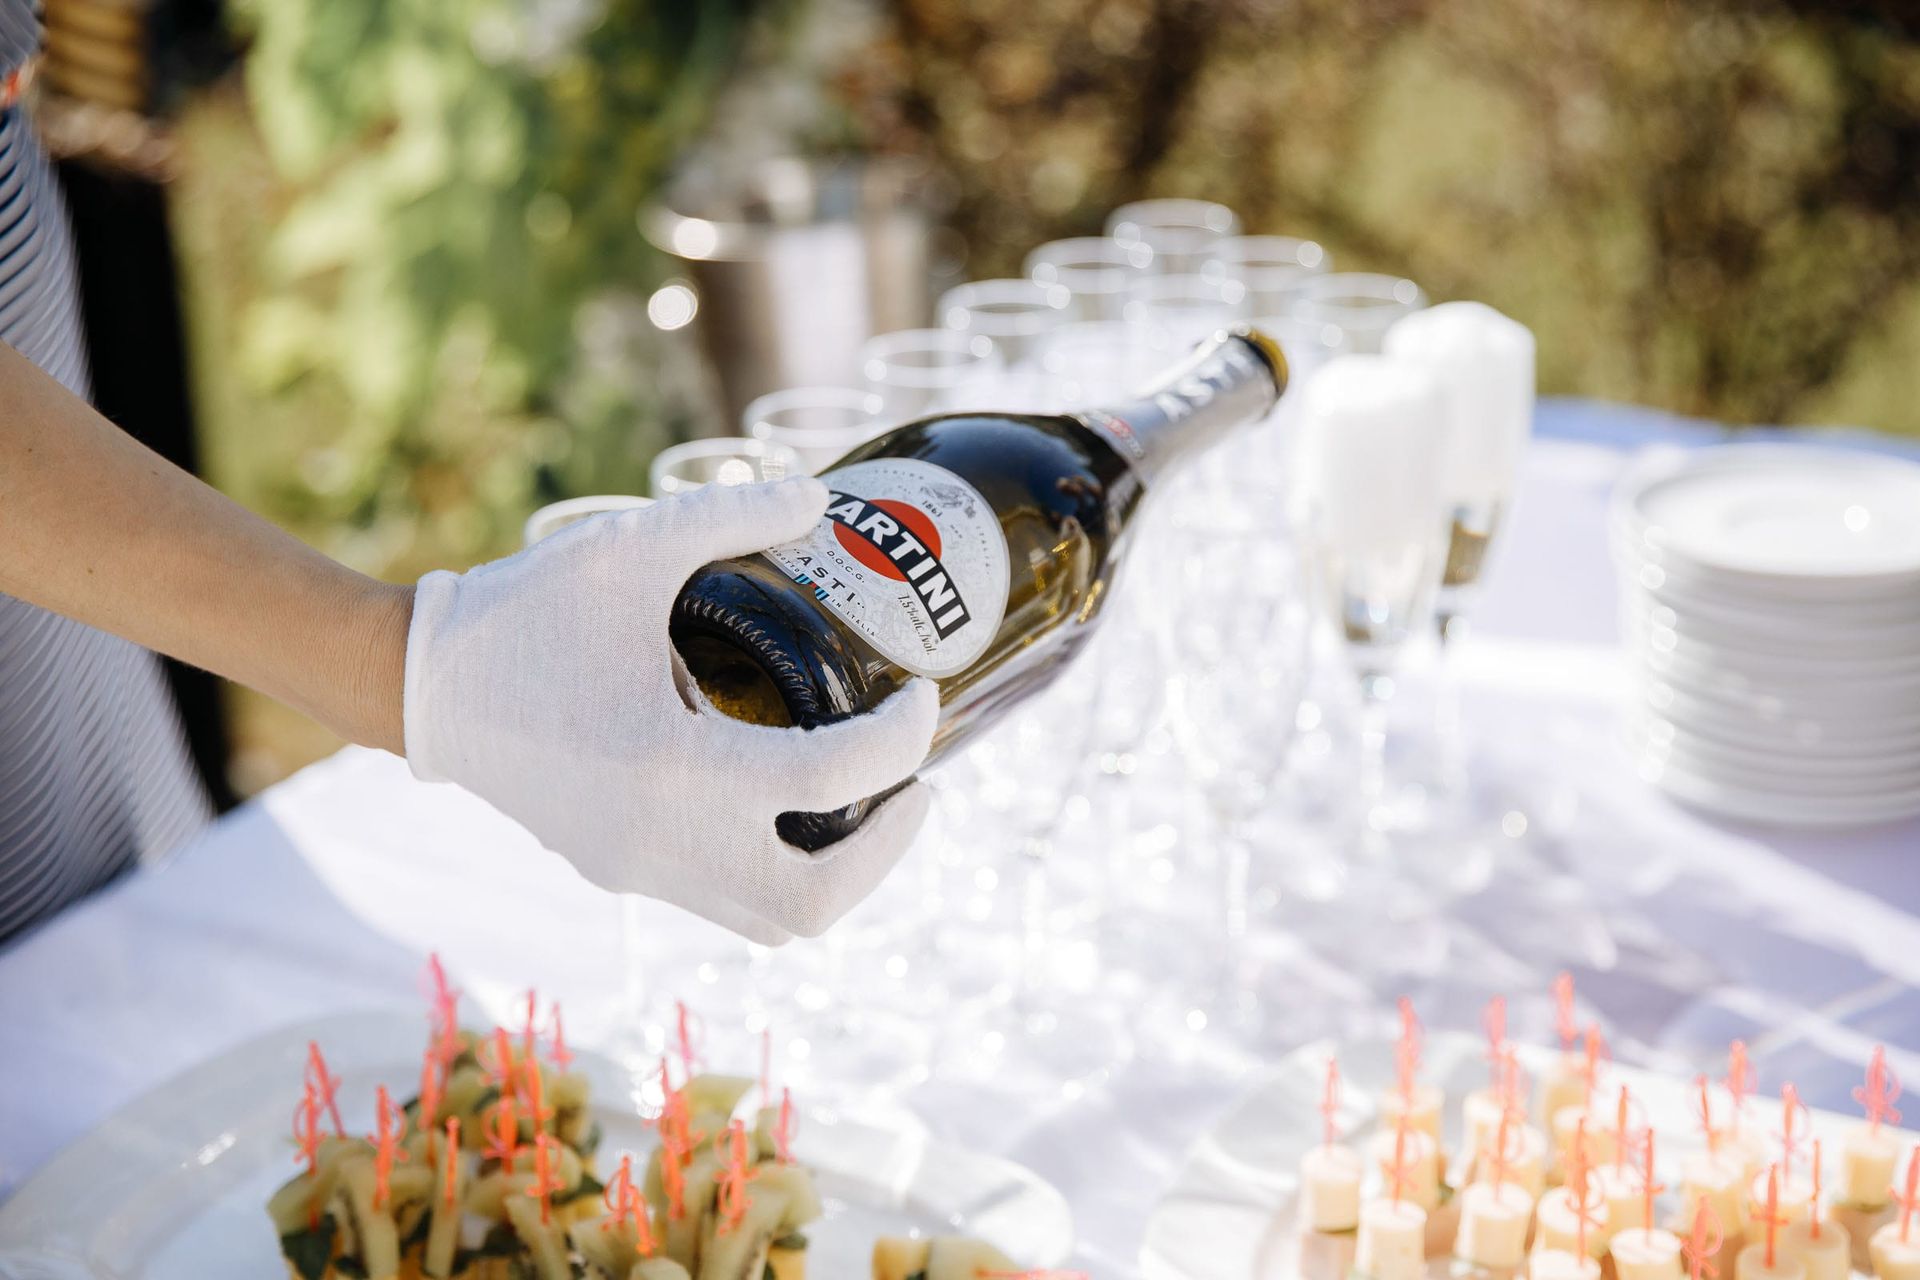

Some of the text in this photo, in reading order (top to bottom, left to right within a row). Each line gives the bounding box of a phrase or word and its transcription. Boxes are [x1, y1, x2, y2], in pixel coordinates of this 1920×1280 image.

[797, 556, 856, 602] ASTI
[826, 550, 865, 583] D.O.C.G.
[832, 599, 842, 608] IN
[846, 611, 875, 636] ITALIA
